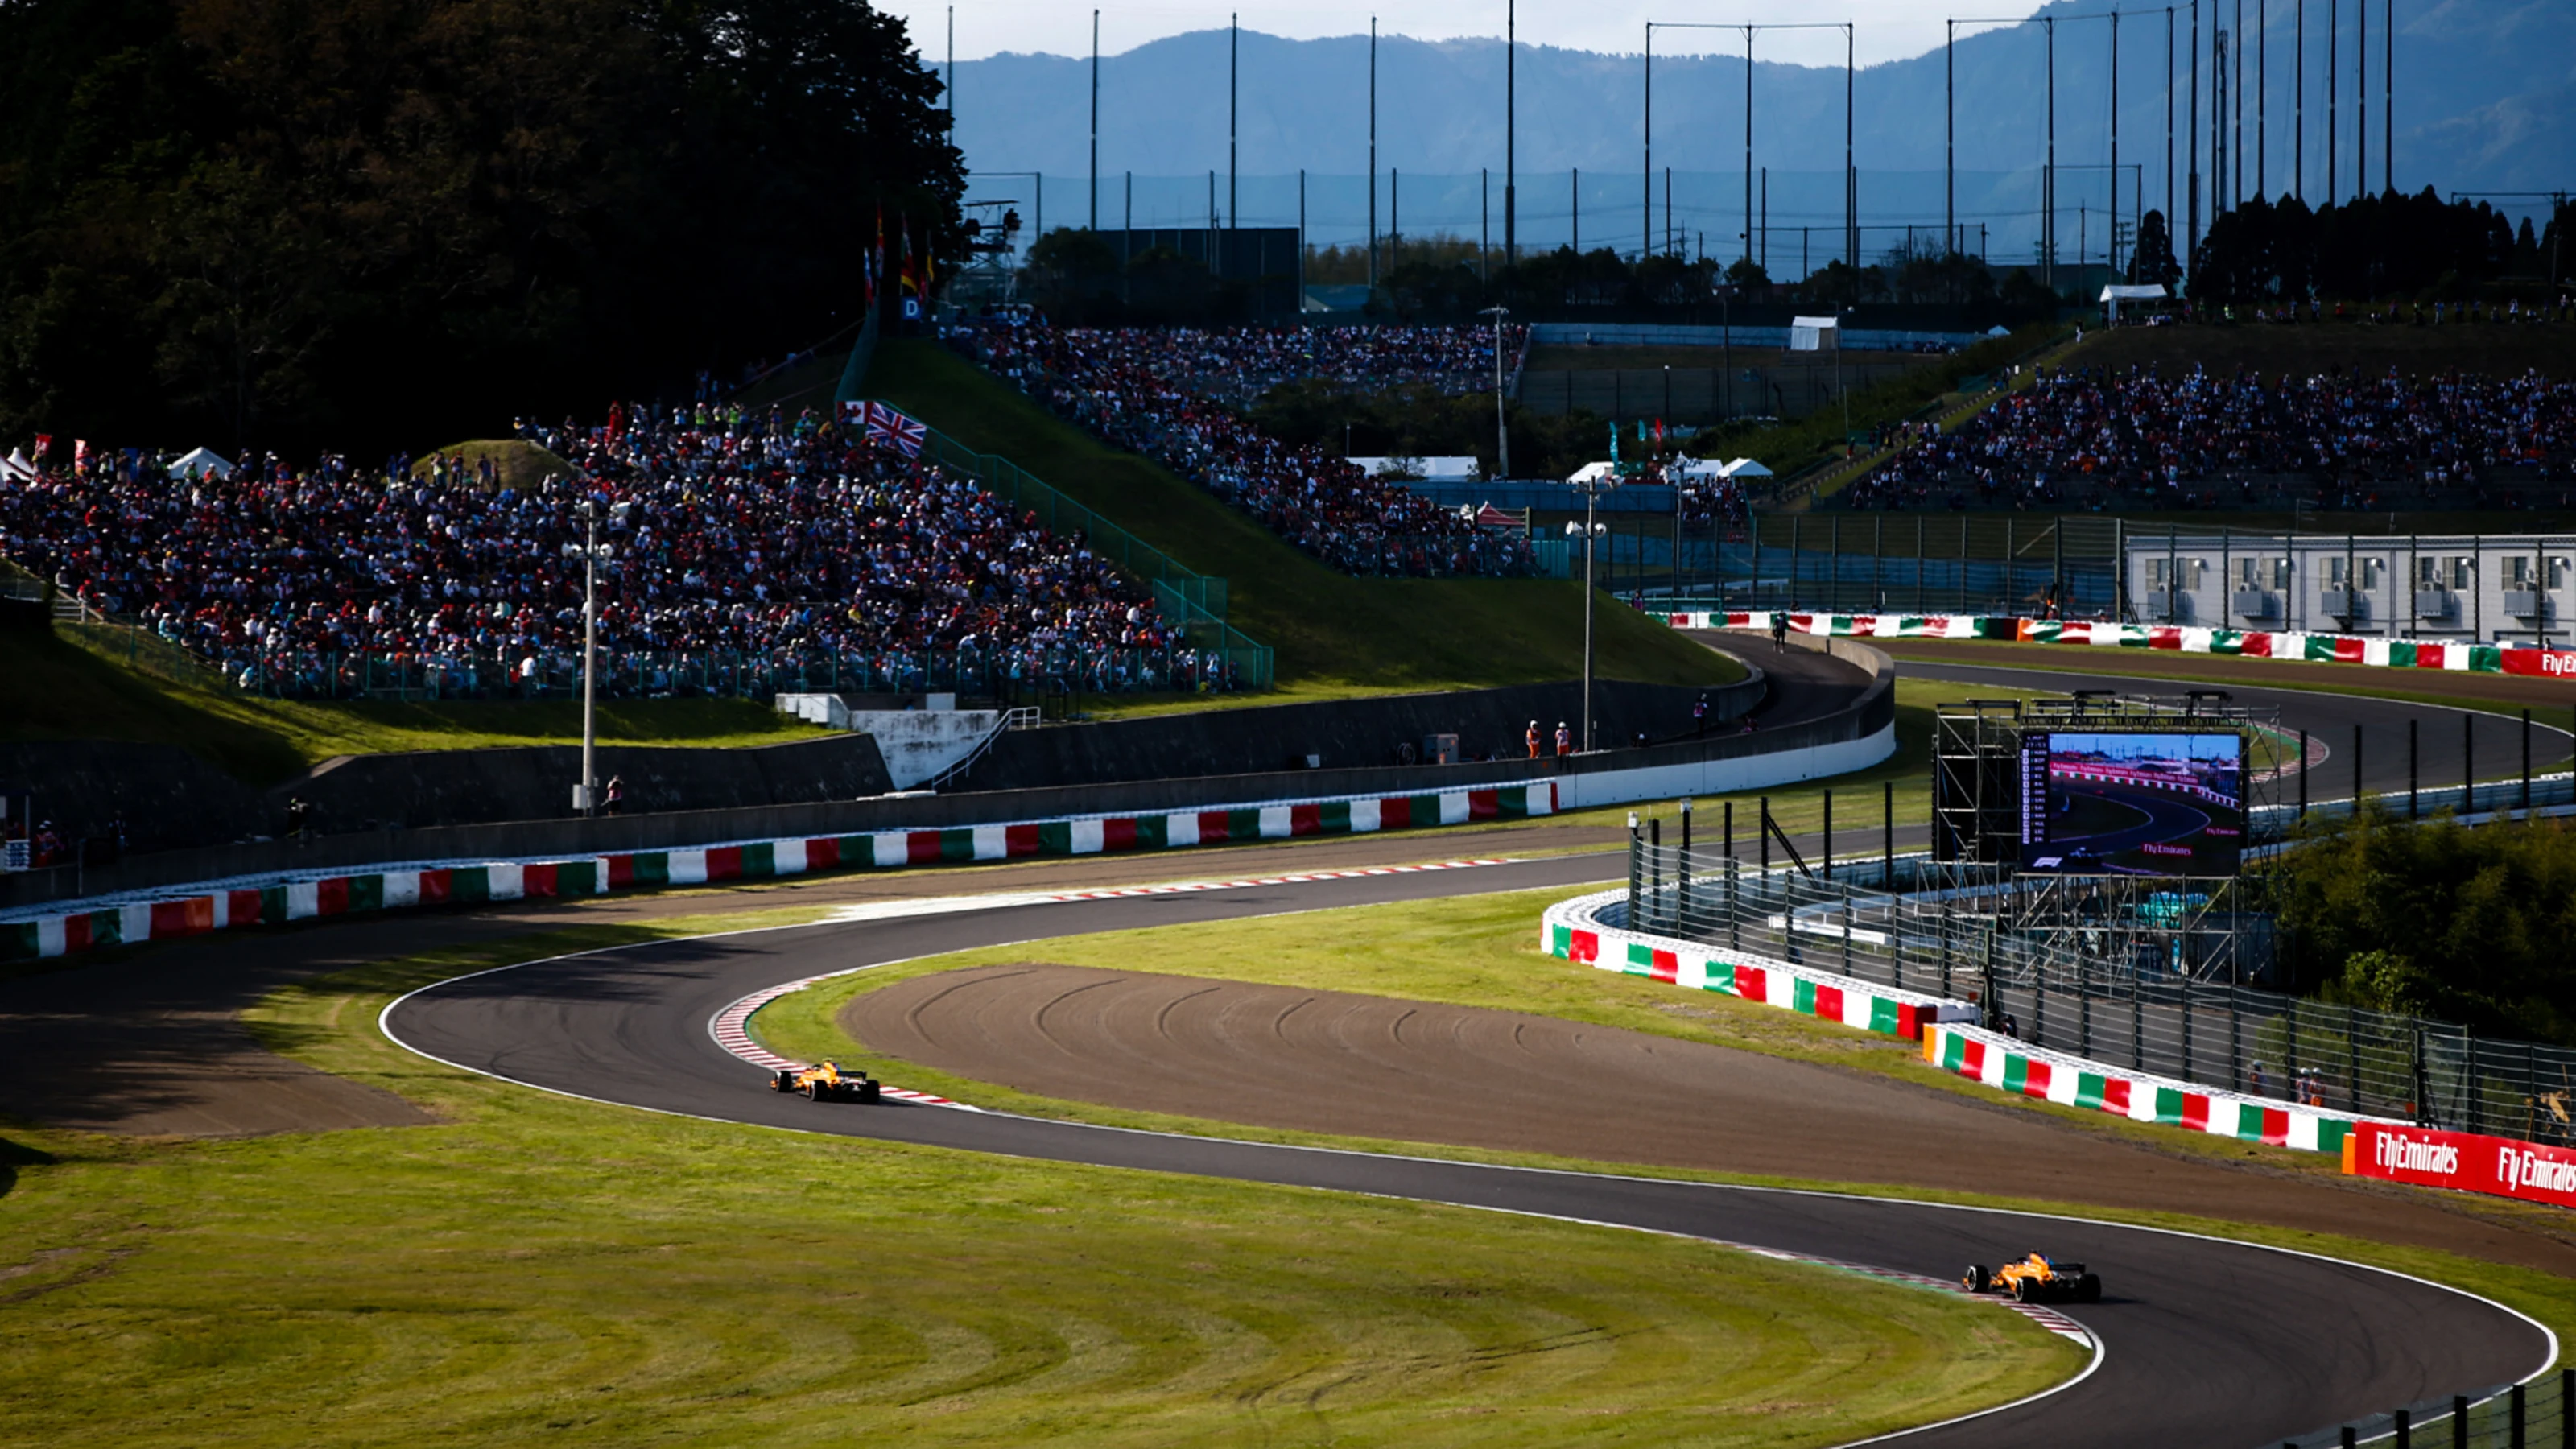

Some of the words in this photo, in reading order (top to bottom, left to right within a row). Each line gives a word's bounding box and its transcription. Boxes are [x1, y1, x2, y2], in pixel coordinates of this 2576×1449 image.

[906, 300, 918, 316] D
[2542, 654, 2562, 675] Fly
[2157, 844, 2191, 856] Emirates
[2376, 1131, 2397, 1175] Fly
[2396, 1134, 2458, 1174] Emirates
[2498, 1146, 2520, 1191] Fly
